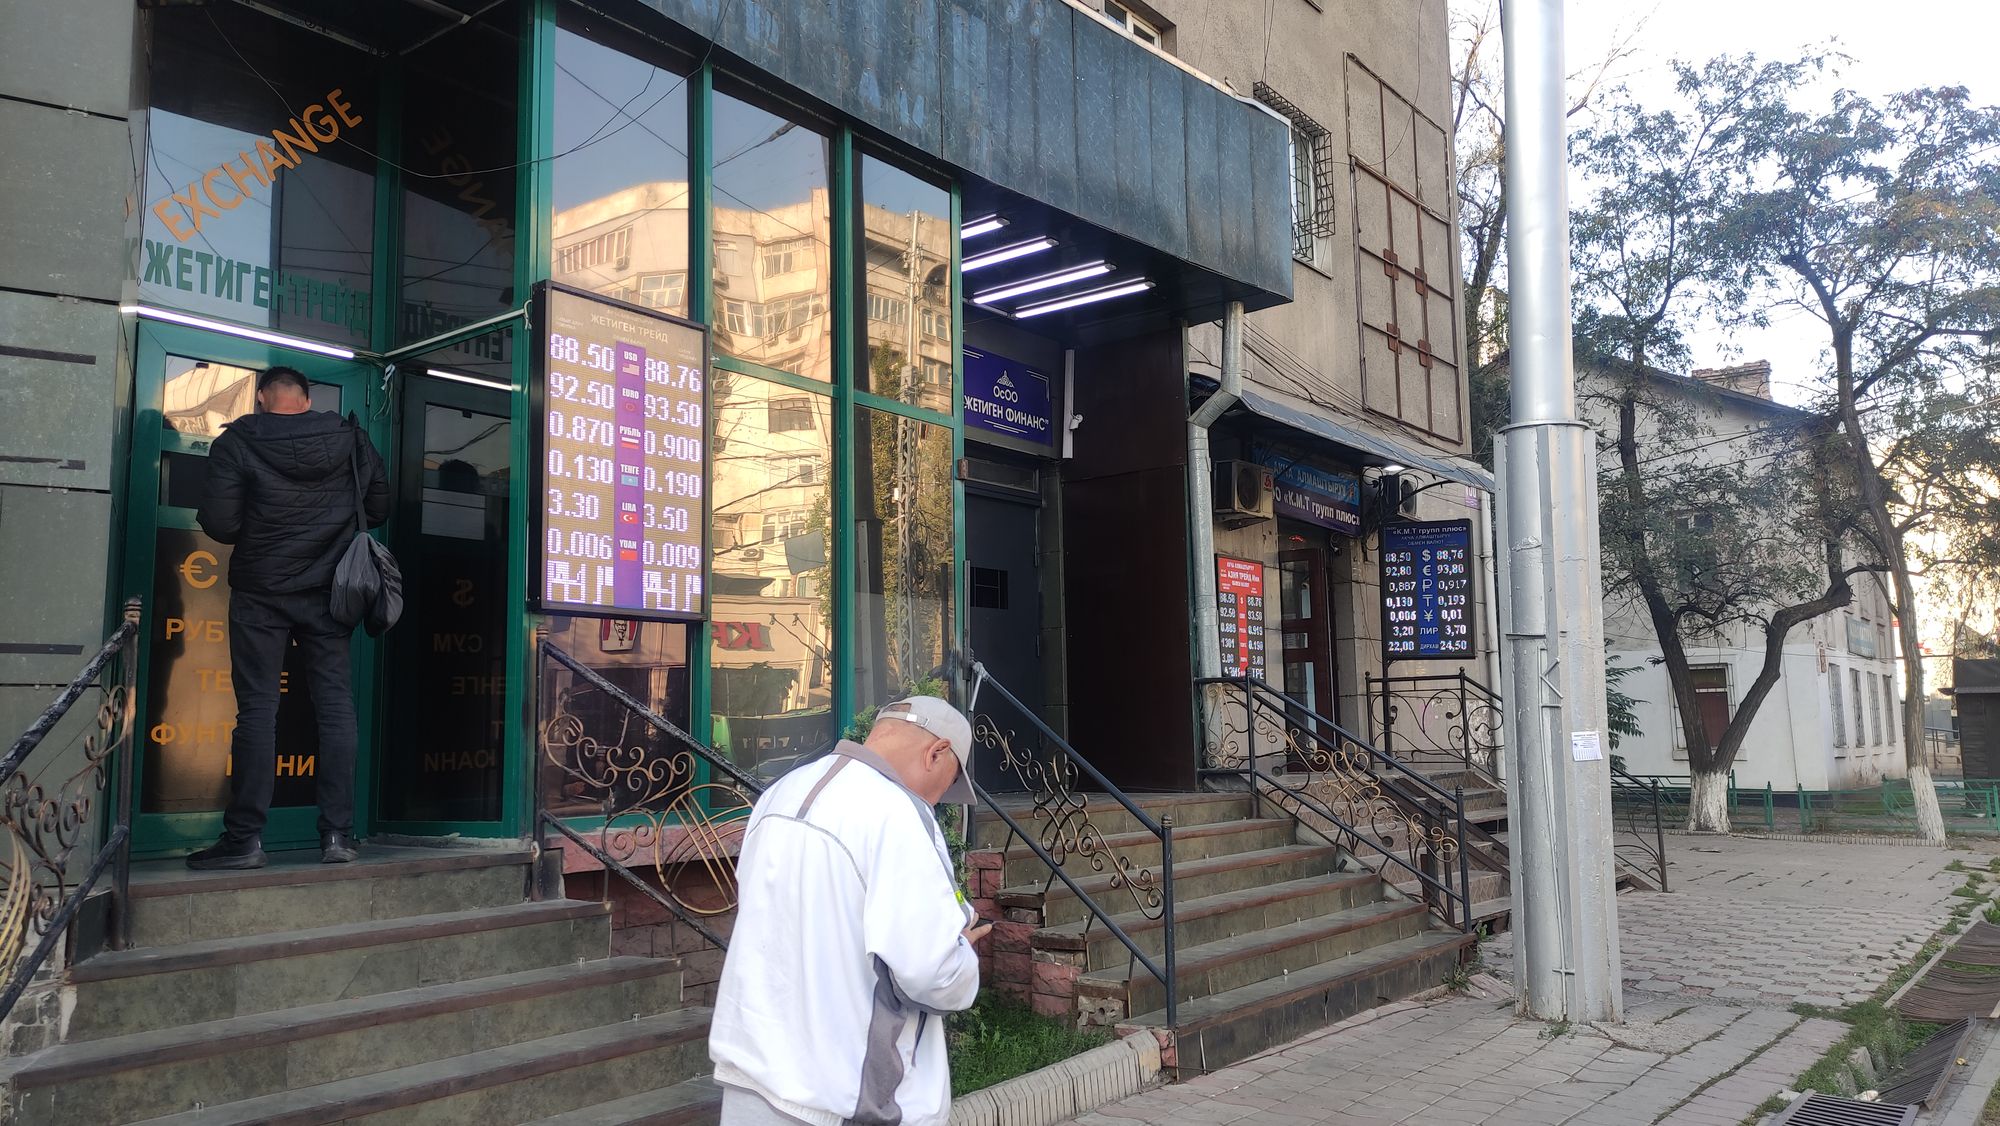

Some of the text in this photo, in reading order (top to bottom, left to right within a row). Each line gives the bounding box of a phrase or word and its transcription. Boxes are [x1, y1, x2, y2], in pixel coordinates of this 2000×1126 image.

[153, 89, 362, 242] EXCHANGE
[590, 314, 636, 333] ЖЕТИГЕН
[638, 325, 669, 344] ТРЕЙД
[550, 333, 701, 392] 88.50 USD 88.76
[549, 372, 701, 428] 92.50 EURO 93.50
[993, 385, 1018, 403] ОсОО
[549, 411, 701, 462] 0.870 РУБЛЬ 0.900
[548, 449, 614, 484] 0.130
[643, 466, 701, 498] 0.190
[548, 488, 599, 520] 3.30
[643, 503, 688, 532] 3.50
[1312, 502, 1334, 519] групп
[1418, 527, 1440, 535] групп
[547, 528, 700, 569] 0.006 YUAN 0.009
[1422, 549, 1431, 562] $
[179, 550, 219, 589] €
[1385, 564, 1464, 577] 92,80 € 93,80
[1438, 579, 1467, 591] 0,917
[1386, 596, 1413, 608] 0,130
[1437, 595, 1466, 607] 0,193
[1389, 610, 1417, 622] 0,006
[1441, 609, 1463, 621] 0,01
[1392, 625, 1467, 638] 3,20 ЛИР 3,70
[1387, 641, 1415, 653] 22,00
[1440, 640, 1467, 652] 24,50
